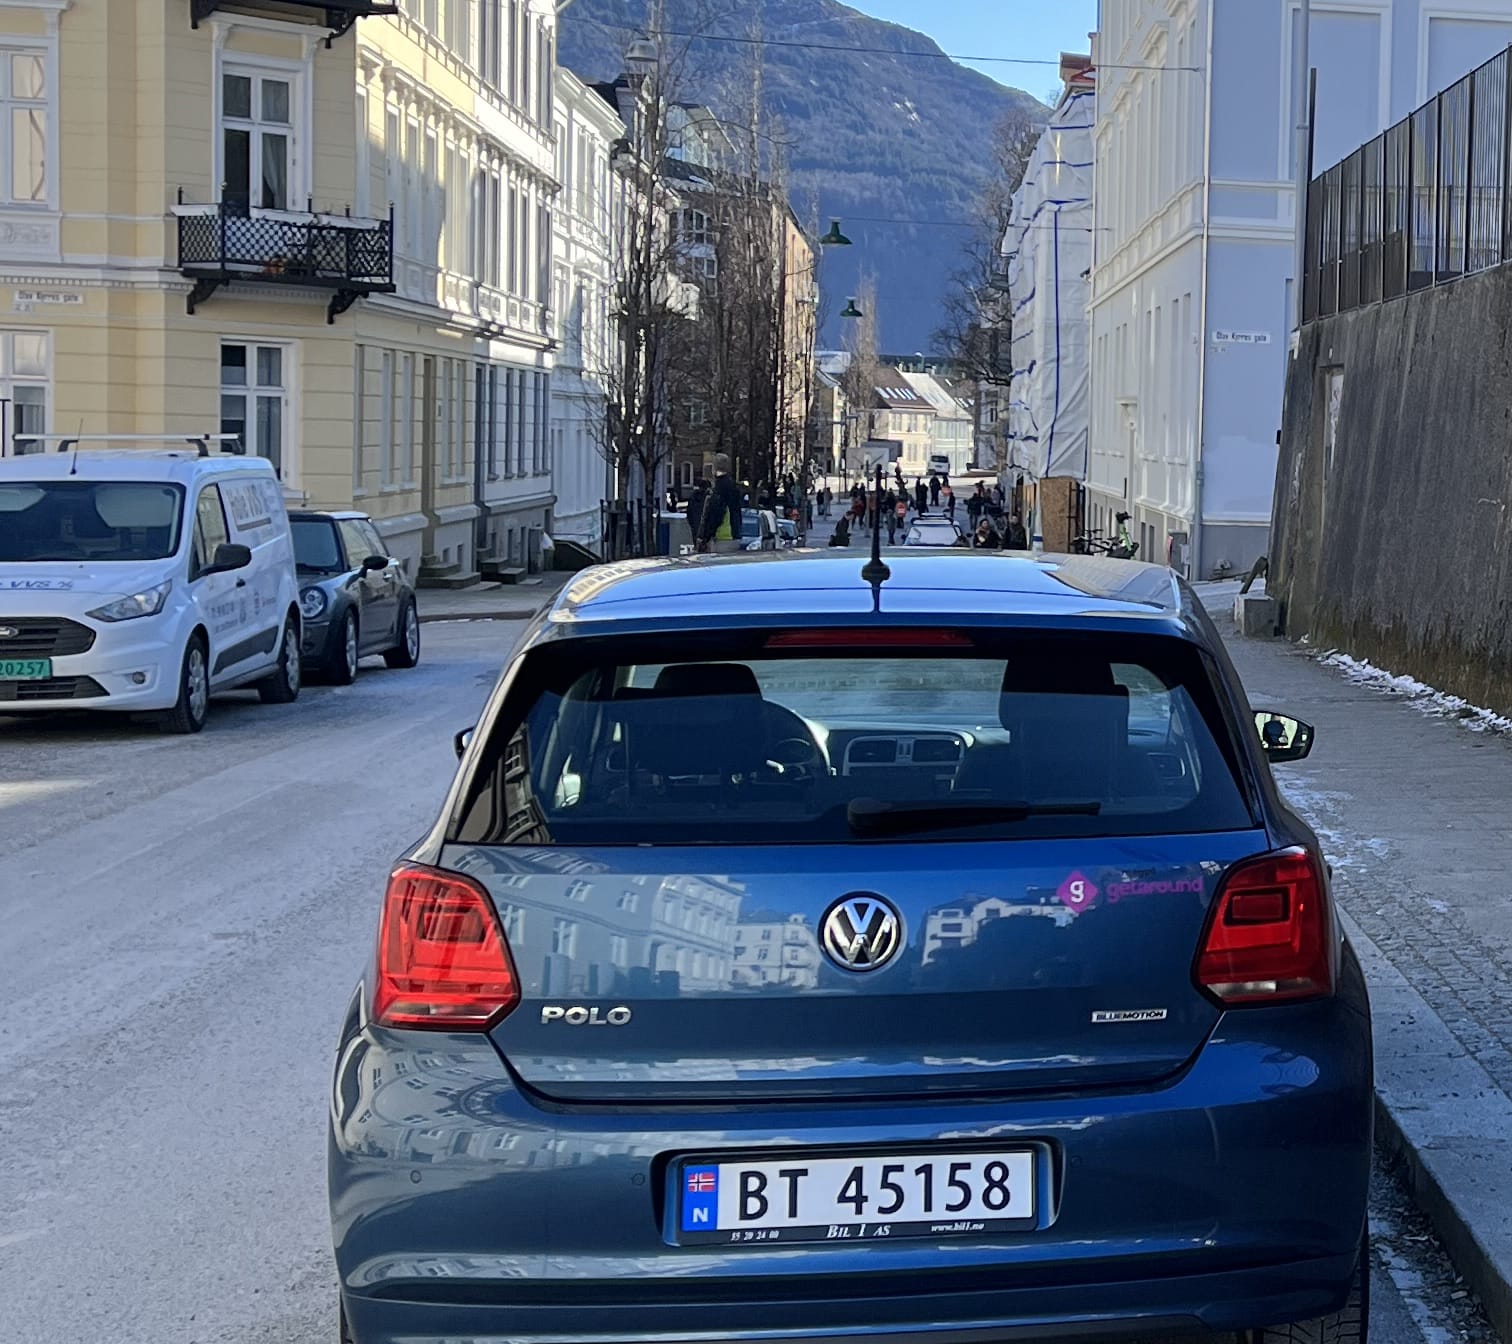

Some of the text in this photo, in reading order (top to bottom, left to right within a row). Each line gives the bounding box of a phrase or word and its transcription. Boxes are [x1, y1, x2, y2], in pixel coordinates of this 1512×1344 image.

[1106, 876, 1204, 903] getaround
[540, 1005, 632, 1025] POLO
[738, 1160, 1011, 1221] BT 45158
[692, 1207, 709, 1223] N
